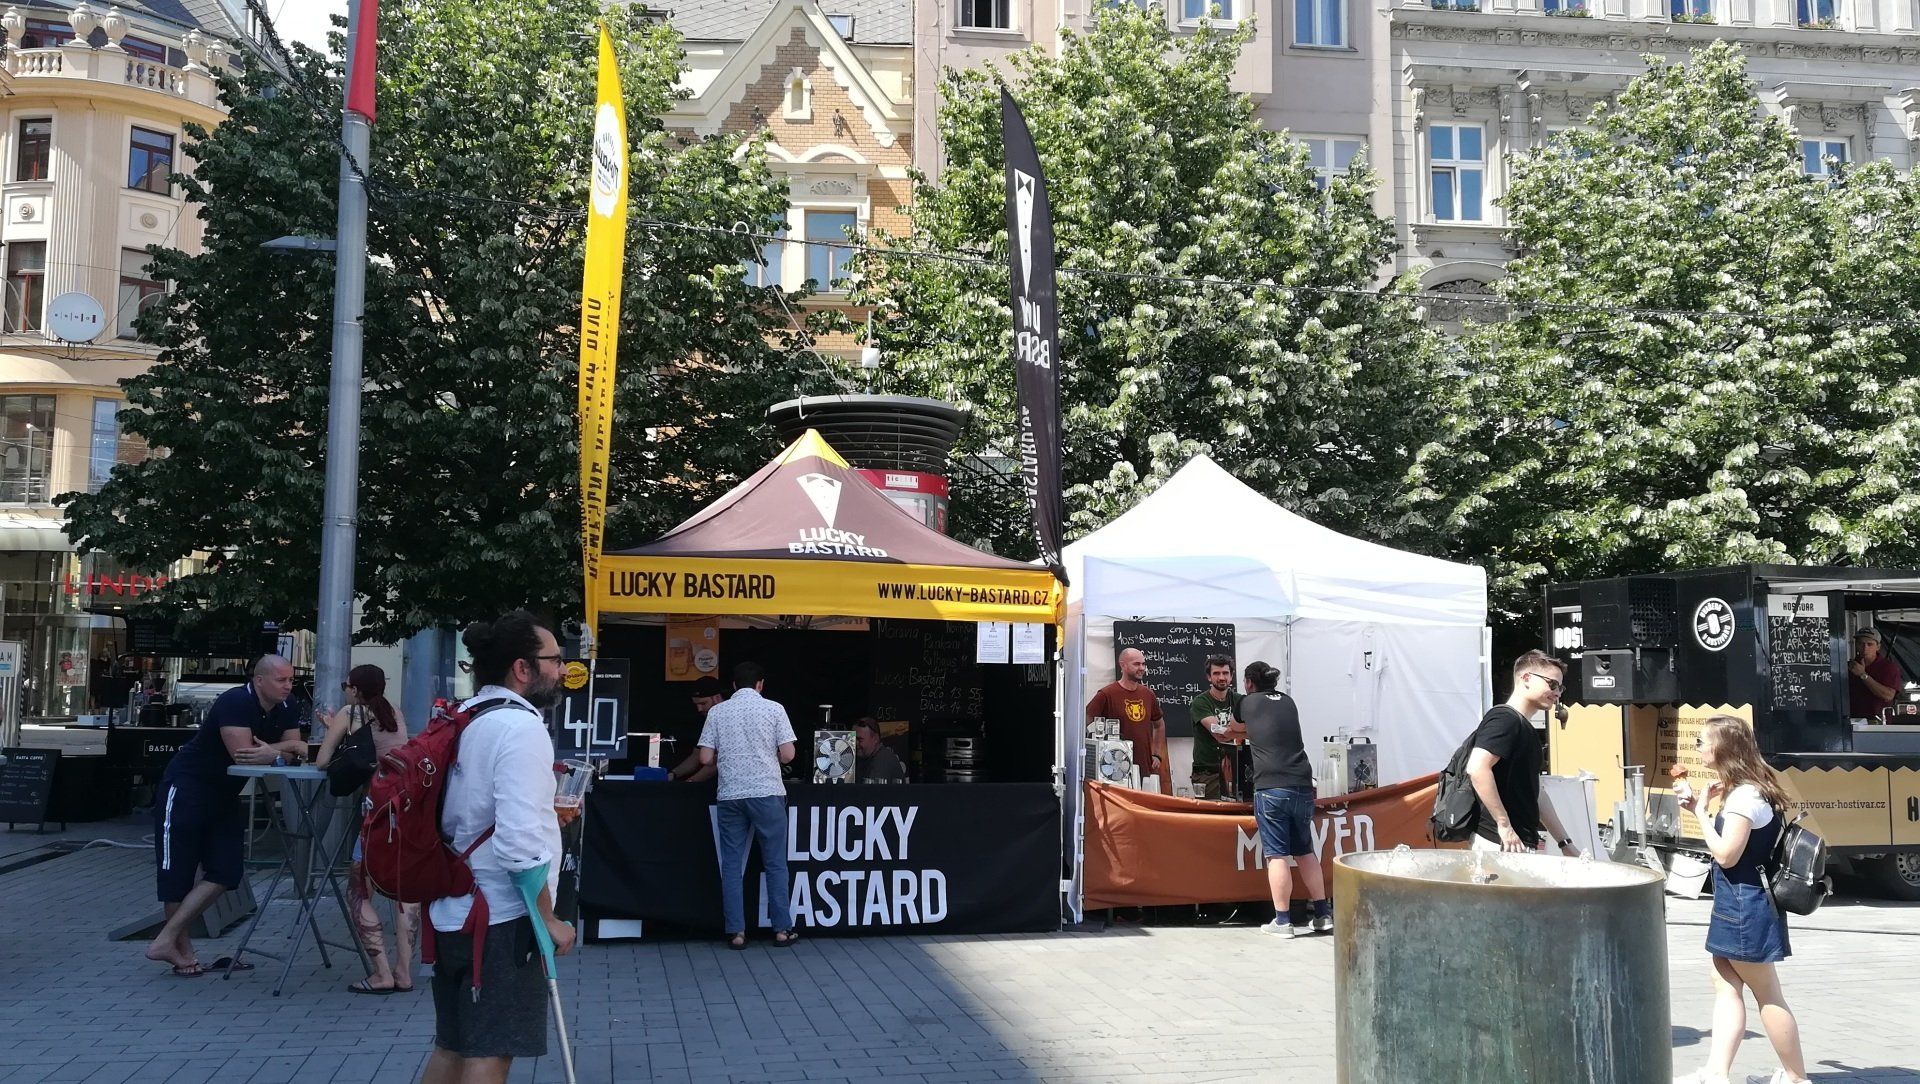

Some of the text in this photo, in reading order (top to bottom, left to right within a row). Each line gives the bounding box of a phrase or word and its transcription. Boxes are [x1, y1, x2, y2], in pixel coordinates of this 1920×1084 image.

[800, 527, 864, 546] LUCKY
[788, 541, 888, 558] BASTARD
[609, 571, 775, 599] LUCKY BASTARD
[878, 583, 1049, 605] WWW.LUCKY-BASTARD.CZ
[1783, 602, 1814, 612] HOSVAR
[787, 806, 919, 862] LUCKY
[1236, 808, 1375, 871] MVĚD
